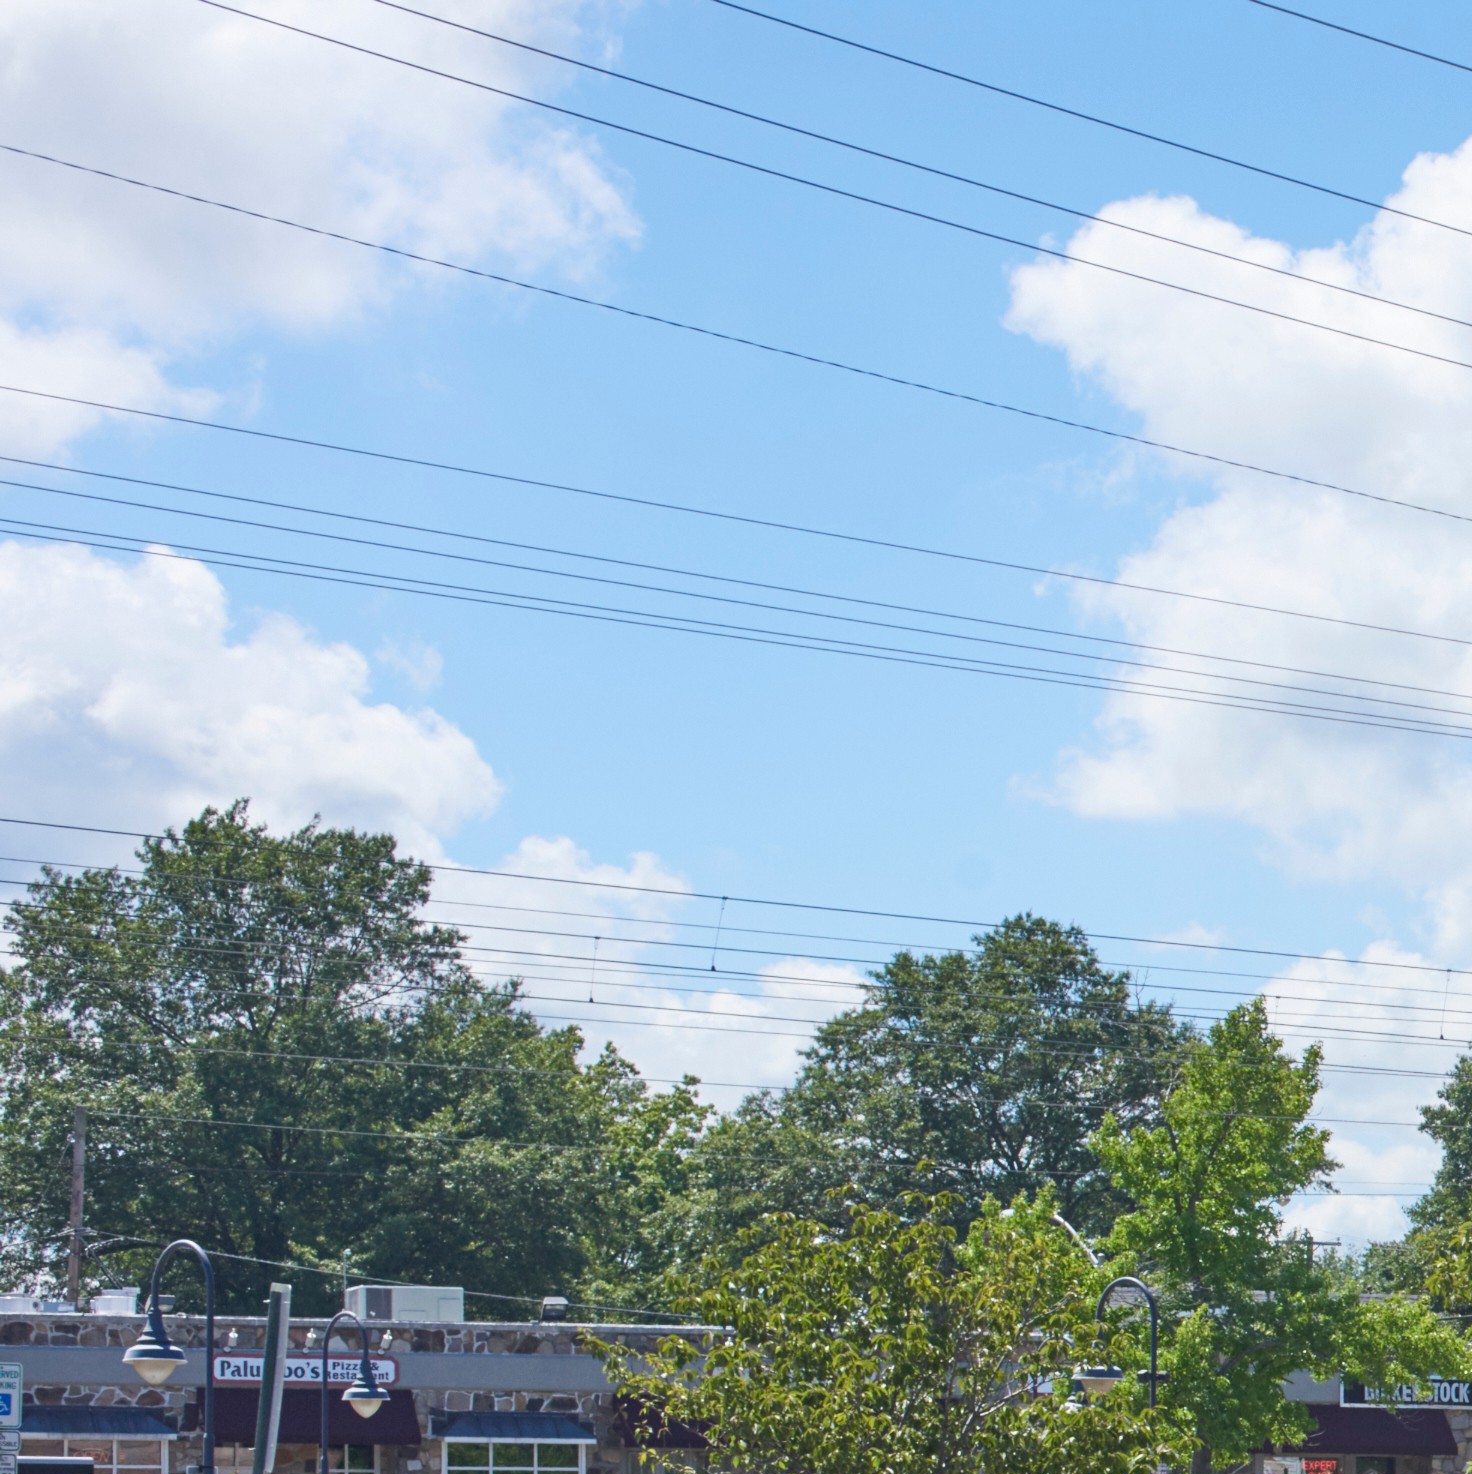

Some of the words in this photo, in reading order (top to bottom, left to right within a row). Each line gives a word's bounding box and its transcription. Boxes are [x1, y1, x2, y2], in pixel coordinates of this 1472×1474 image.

[220, 1360, 320, 1379] Paluo's
[332, 1362, 364, 1371] Pizz
[1364, 1382, 1470, 1403] BIKETOCK
[1303, 1460, 1337, 1470] EXPERT
